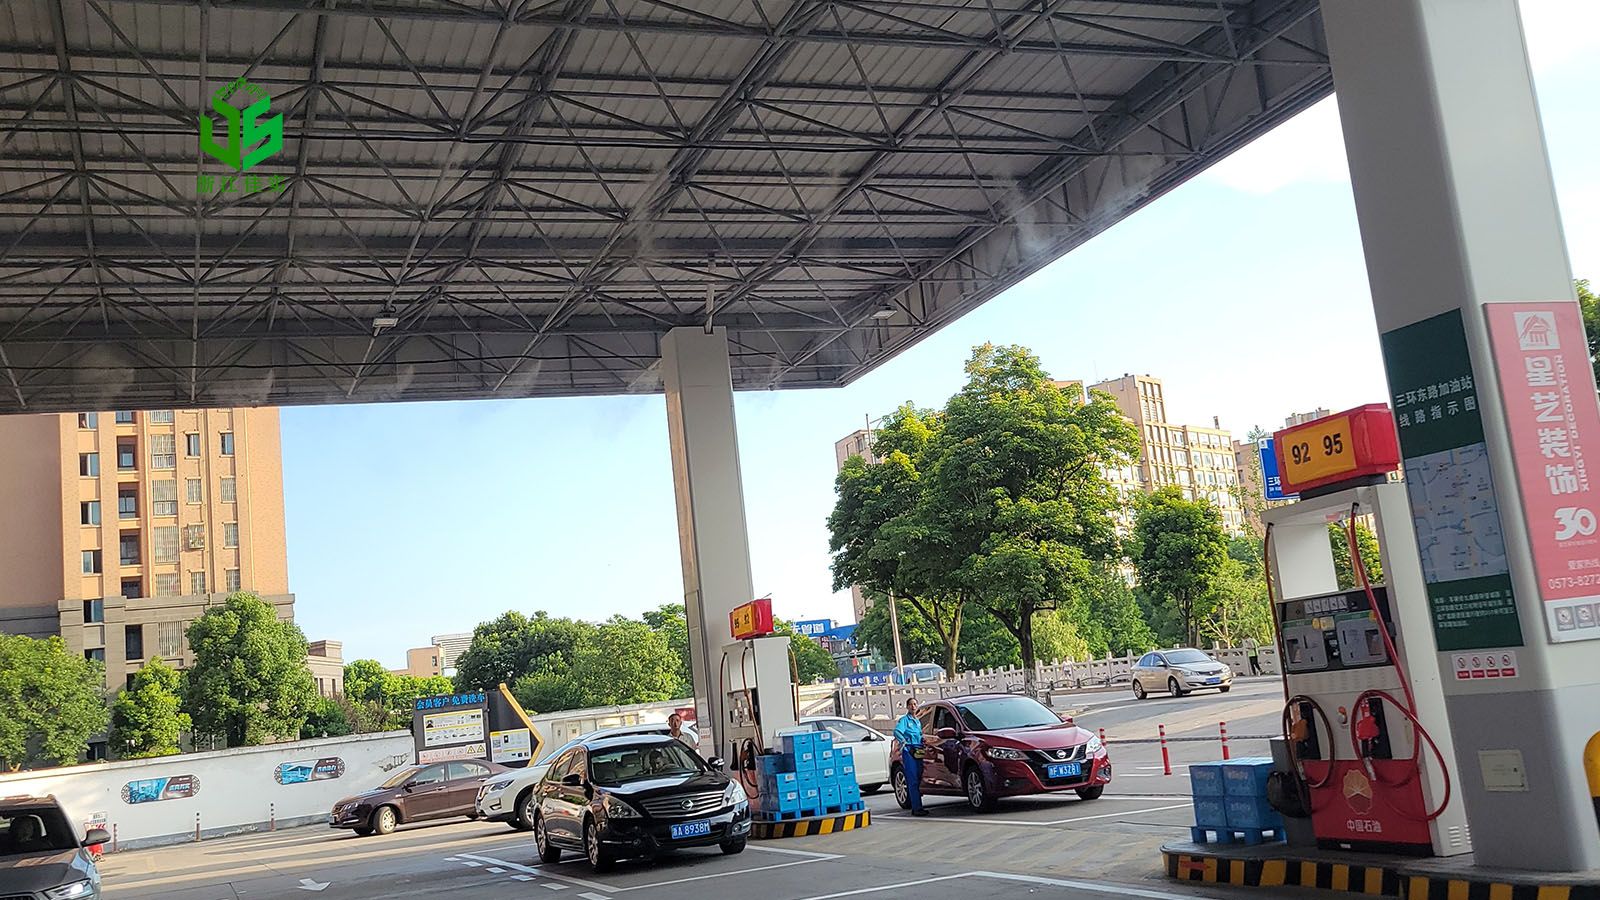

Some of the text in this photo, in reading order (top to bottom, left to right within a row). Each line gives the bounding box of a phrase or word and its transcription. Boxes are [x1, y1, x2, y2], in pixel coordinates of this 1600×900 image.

[1395, 375, 1473, 408] 三环东路加油站
[1399, 395, 1476, 428] 线路指示图
[1524, 356, 1579, 496] 星艺装饰
[1554, 355, 1590, 493] XINGYI DECORATION
[1291, 433, 1343, 465] 92 95
[1554, 507, 1597, 541] 30
[1346, 819, 1382, 833] 中国石油
